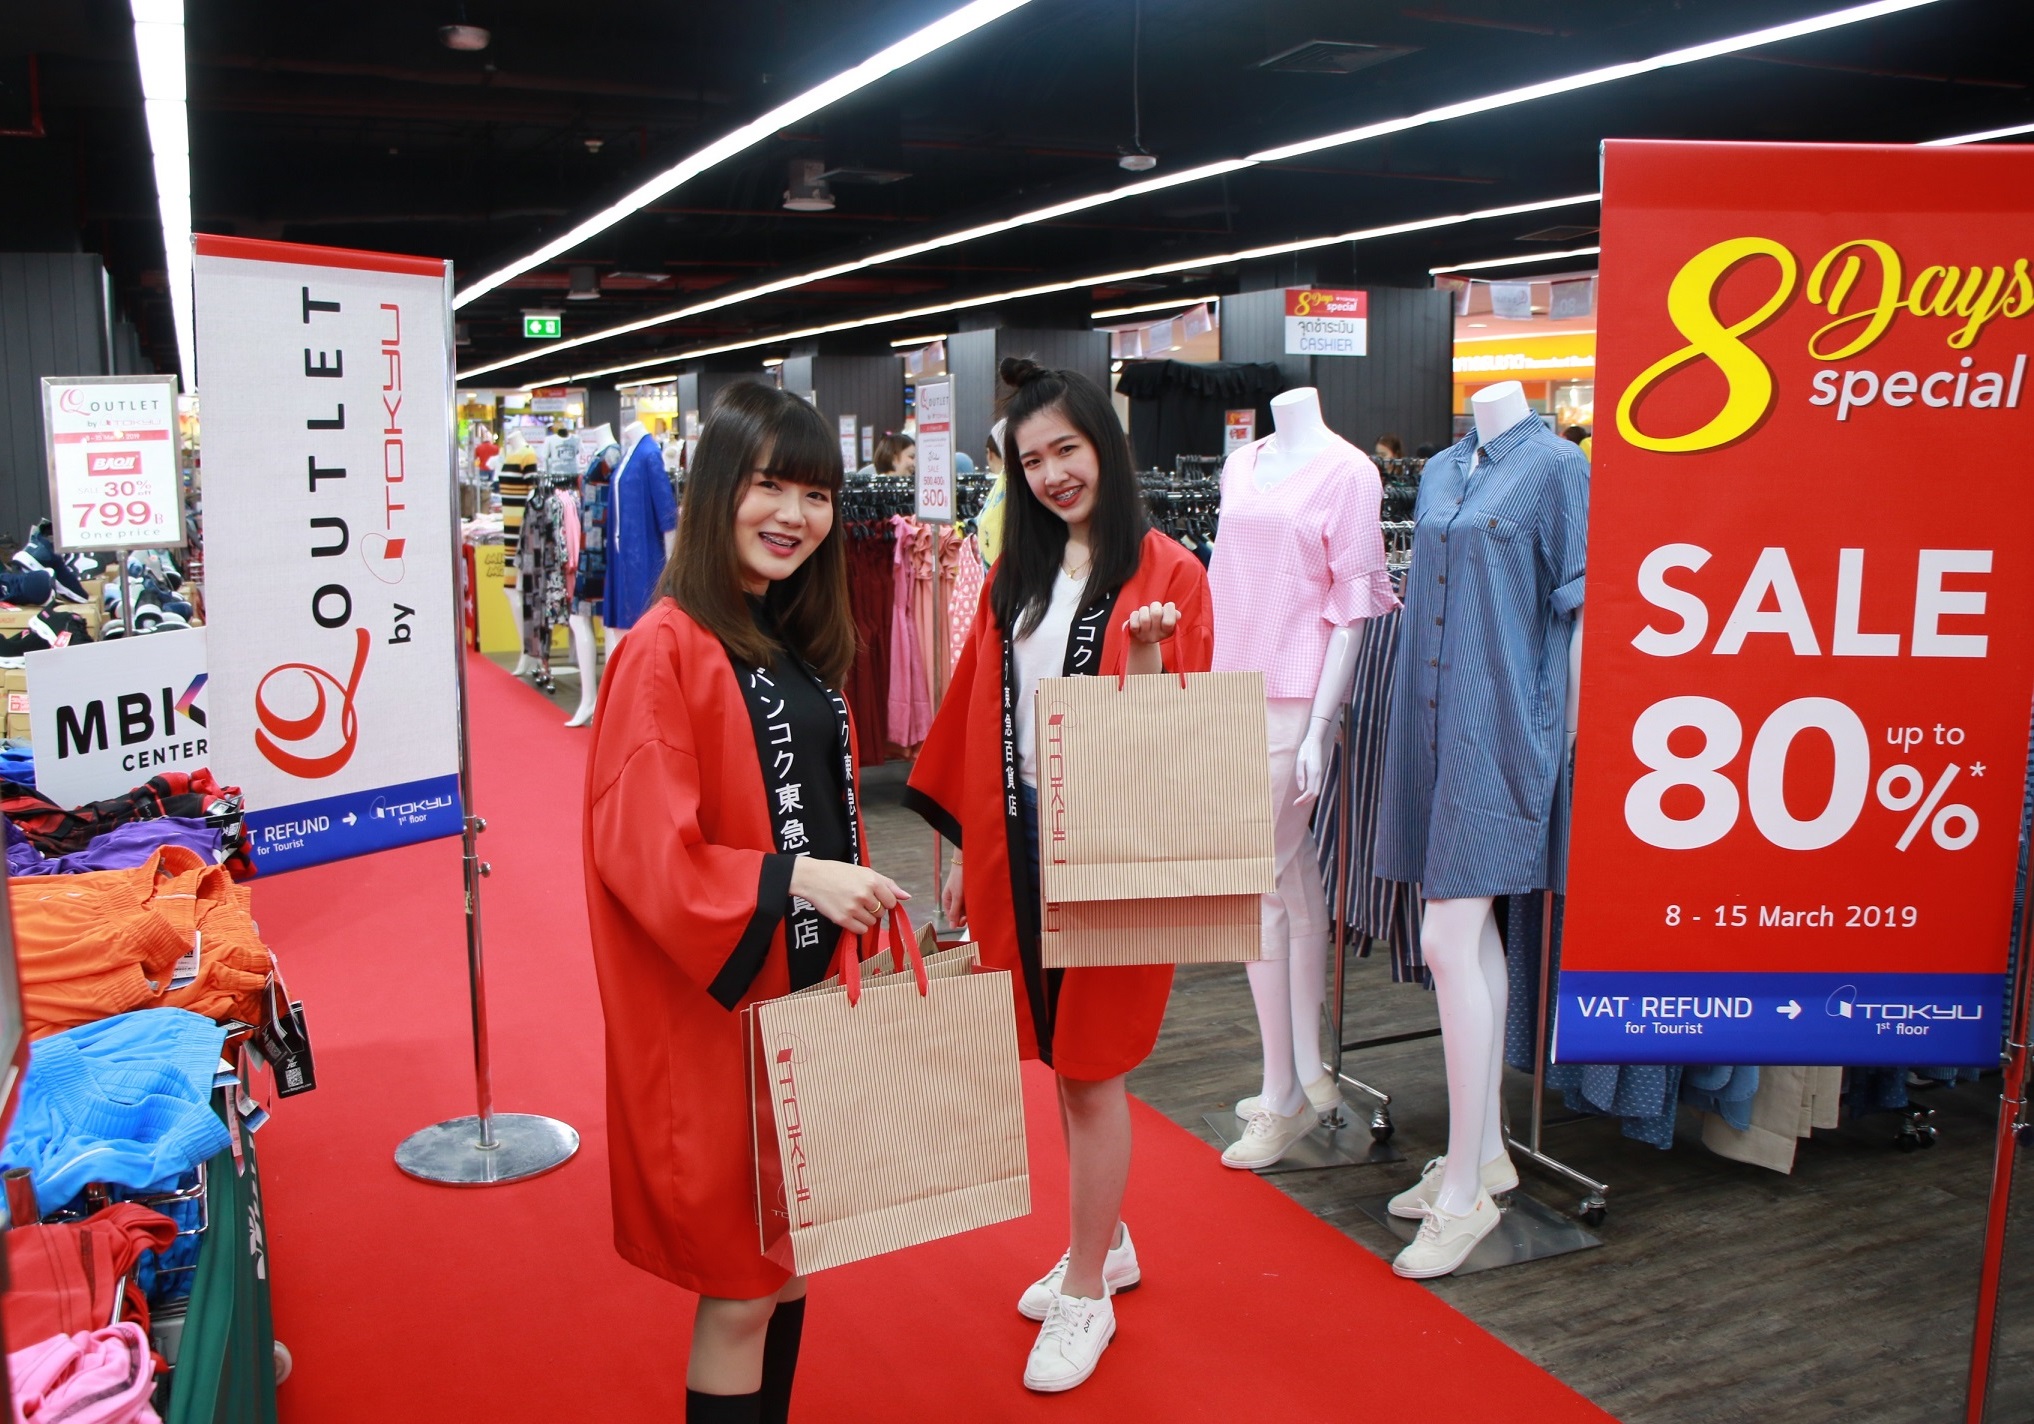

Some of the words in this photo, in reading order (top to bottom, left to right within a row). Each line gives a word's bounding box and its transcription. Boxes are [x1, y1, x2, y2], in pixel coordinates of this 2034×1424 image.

[1294, 291, 1311, 316] 8
[1327, 301, 1358, 313] special
[1300, 337, 1353, 352] CASHIER
[1616, 237, 1797, 453] 8
[1808, 354, 2027, 422] special
[90, 400, 159, 412] OUTLET
[380, 303, 406, 531] TOKYU
[87, 420, 97, 429] by
[302, 286, 352, 629] OUTLET
[922, 488, 945, 507] 300
[72, 500, 152, 529] 799
[80, 530, 113, 540] One
[118, 528, 161, 540] price
[1630, 542, 1994, 658] SALE
[388, 602, 416, 645] by
[56, 672, 209, 760] MBK
[1885, 725, 1925, 754] up
[1933, 722, 1966, 745] to
[122, 738, 208, 772] CENTER
[385, 794, 452, 818] TOKYU
[1047, 726, 1067, 866] TOKYU
[264, 815, 330, 842] REFUND
[409, 812, 427, 825] floor
[257, 845, 270, 856] for
[273, 838, 305, 853] Tourist
[1664, 904, 1681, 927] 8
[1715, 904, 1748, 926] 15
[1759, 904, 1834, 928] March
[1845, 904, 1919, 928] 2019
[1577, 996, 1629, 1018] VAT
[1642, 996, 1753, 1018] REFUND
[1855, 1003, 1983, 1020] TOKYU
[1624, 1021, 1646, 1035] for
[1652, 1021, 1703, 1035] Tourist
[1875, 1021, 1891, 1035] 1st
[1895, 1021, 1930, 1036] floor
[778, 1062, 814, 1228] TOKYU
